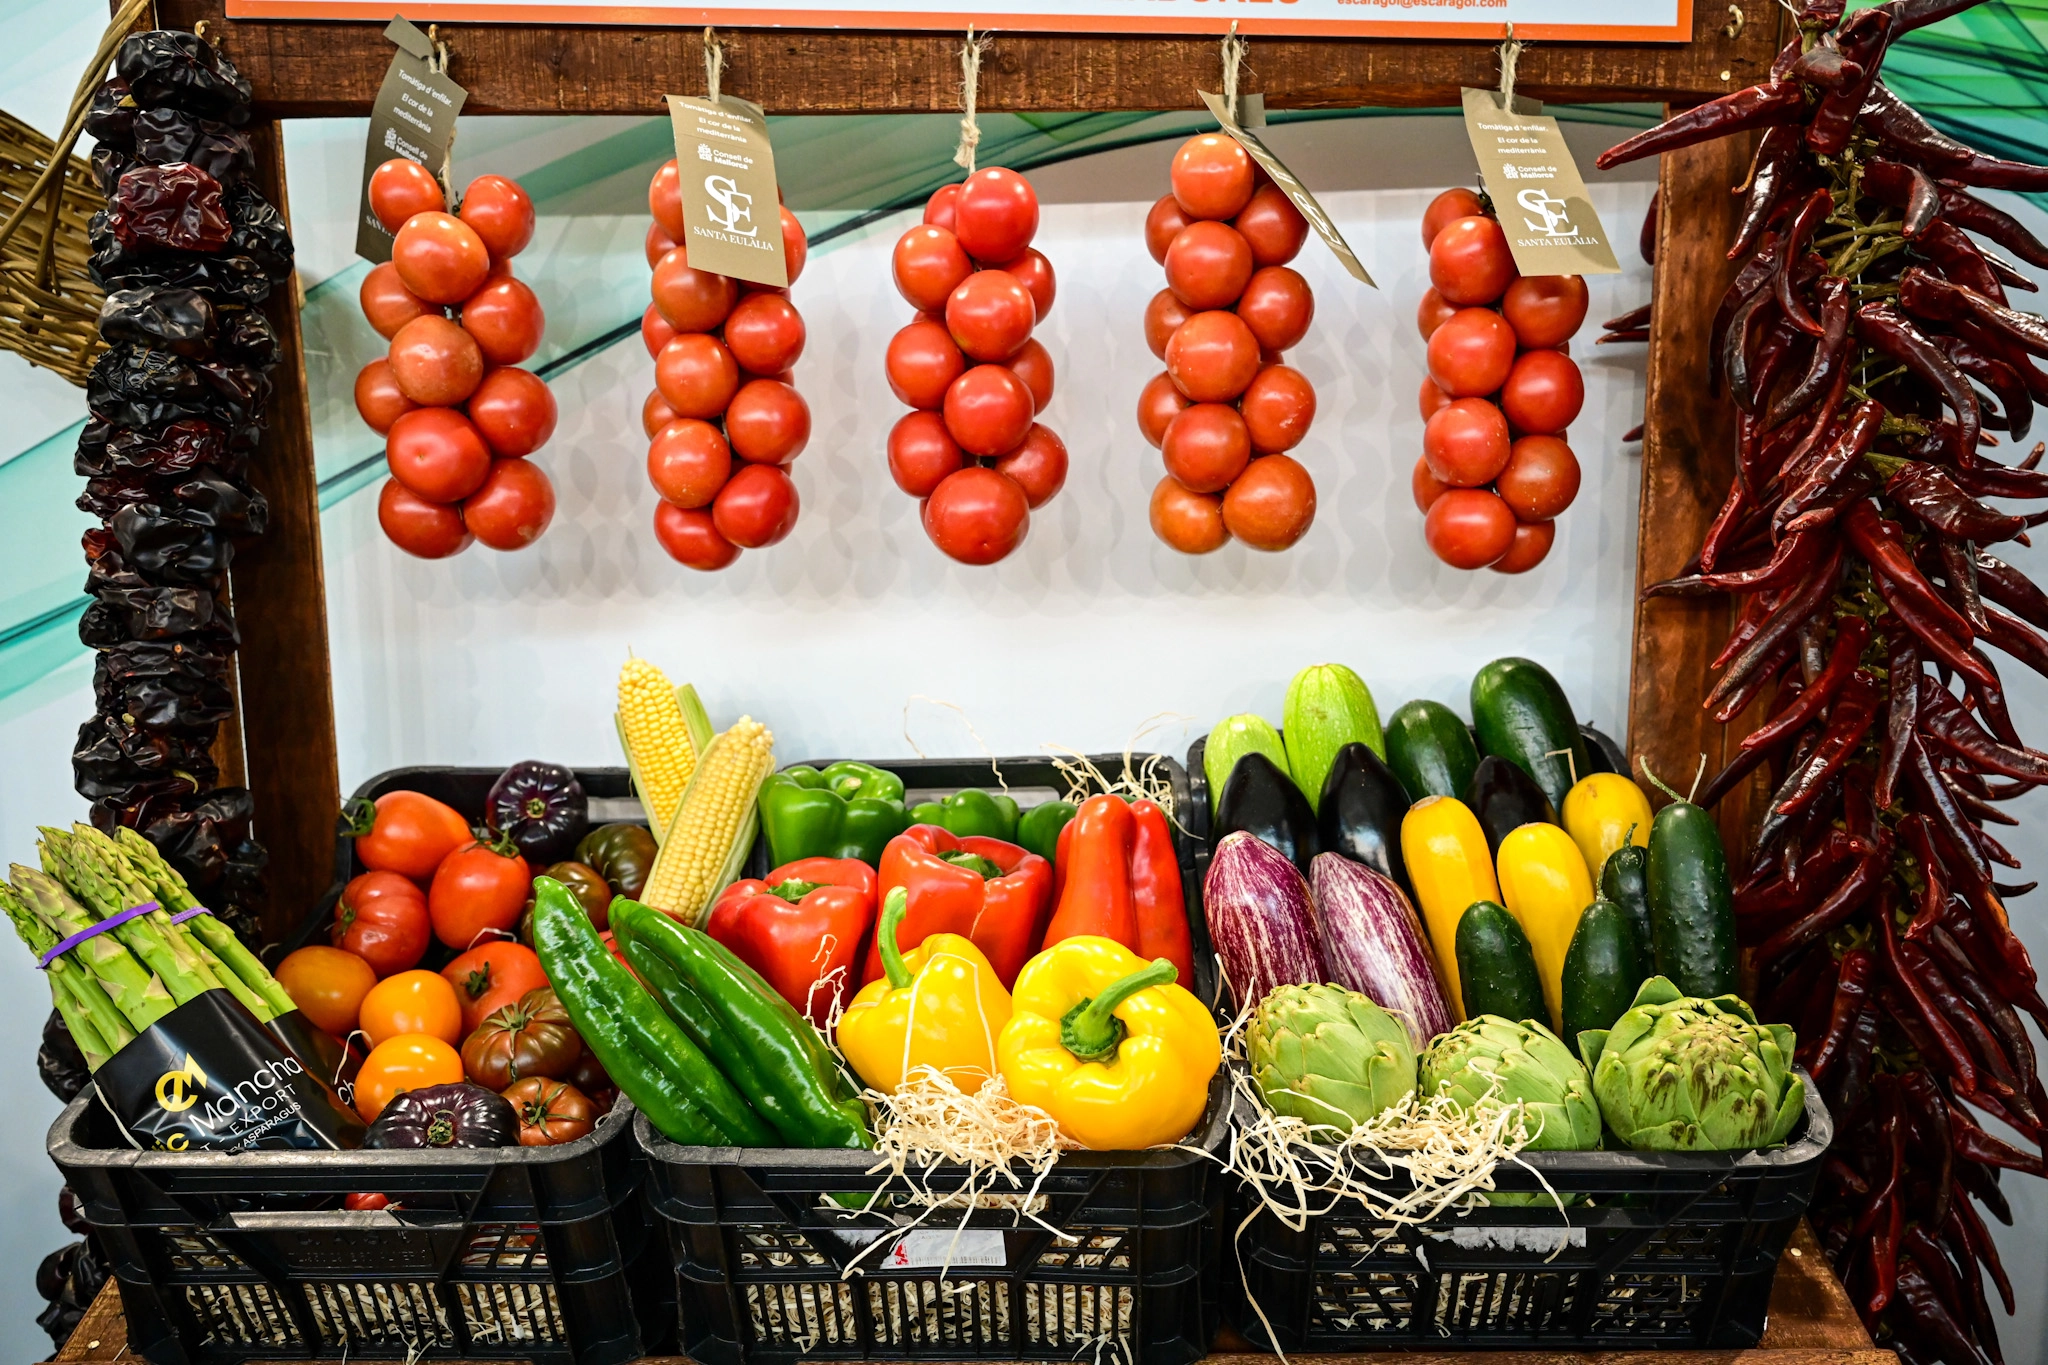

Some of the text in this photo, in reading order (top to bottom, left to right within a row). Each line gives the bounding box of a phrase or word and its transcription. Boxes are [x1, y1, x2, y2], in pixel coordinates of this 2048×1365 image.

[401, 92, 434, 117] El cor de la
[397, 136, 428, 160] Consell de
[713, 149, 754, 164] Consell de
[714, 156, 749, 170] Mallorca
[693, 225, 774, 251] SANTA EULÀLIA
[1517, 235, 1599, 247] SANTA EULÀLIA
[188, 1056, 304, 1137] Mancha
[229, 1083, 297, 1136] EXPORT
[243, 1102, 302, 1147] ASPARAGUS
